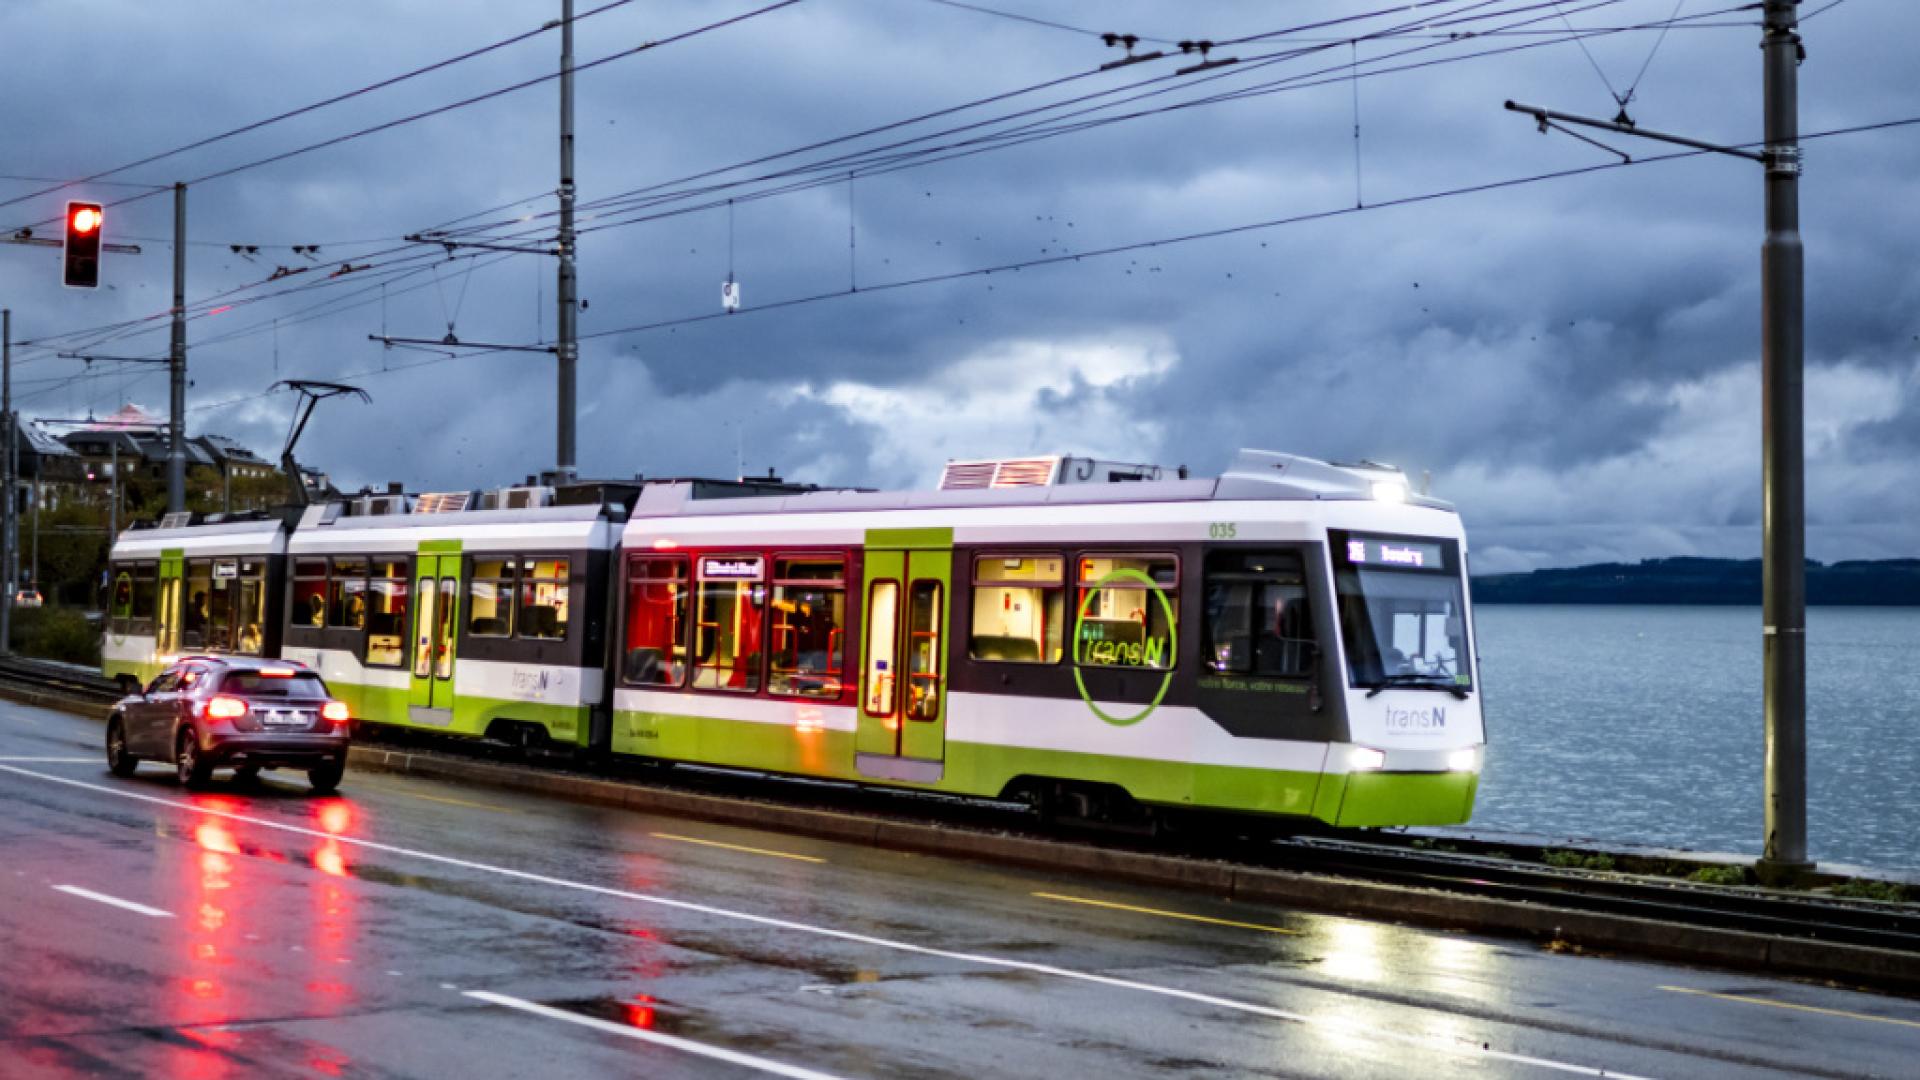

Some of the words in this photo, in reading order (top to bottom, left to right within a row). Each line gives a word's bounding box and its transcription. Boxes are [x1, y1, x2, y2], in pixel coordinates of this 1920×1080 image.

[1209, 523, 1236, 539] 035
[1085, 634, 1164, 667] transN
[1385, 704, 1447, 729] transN
